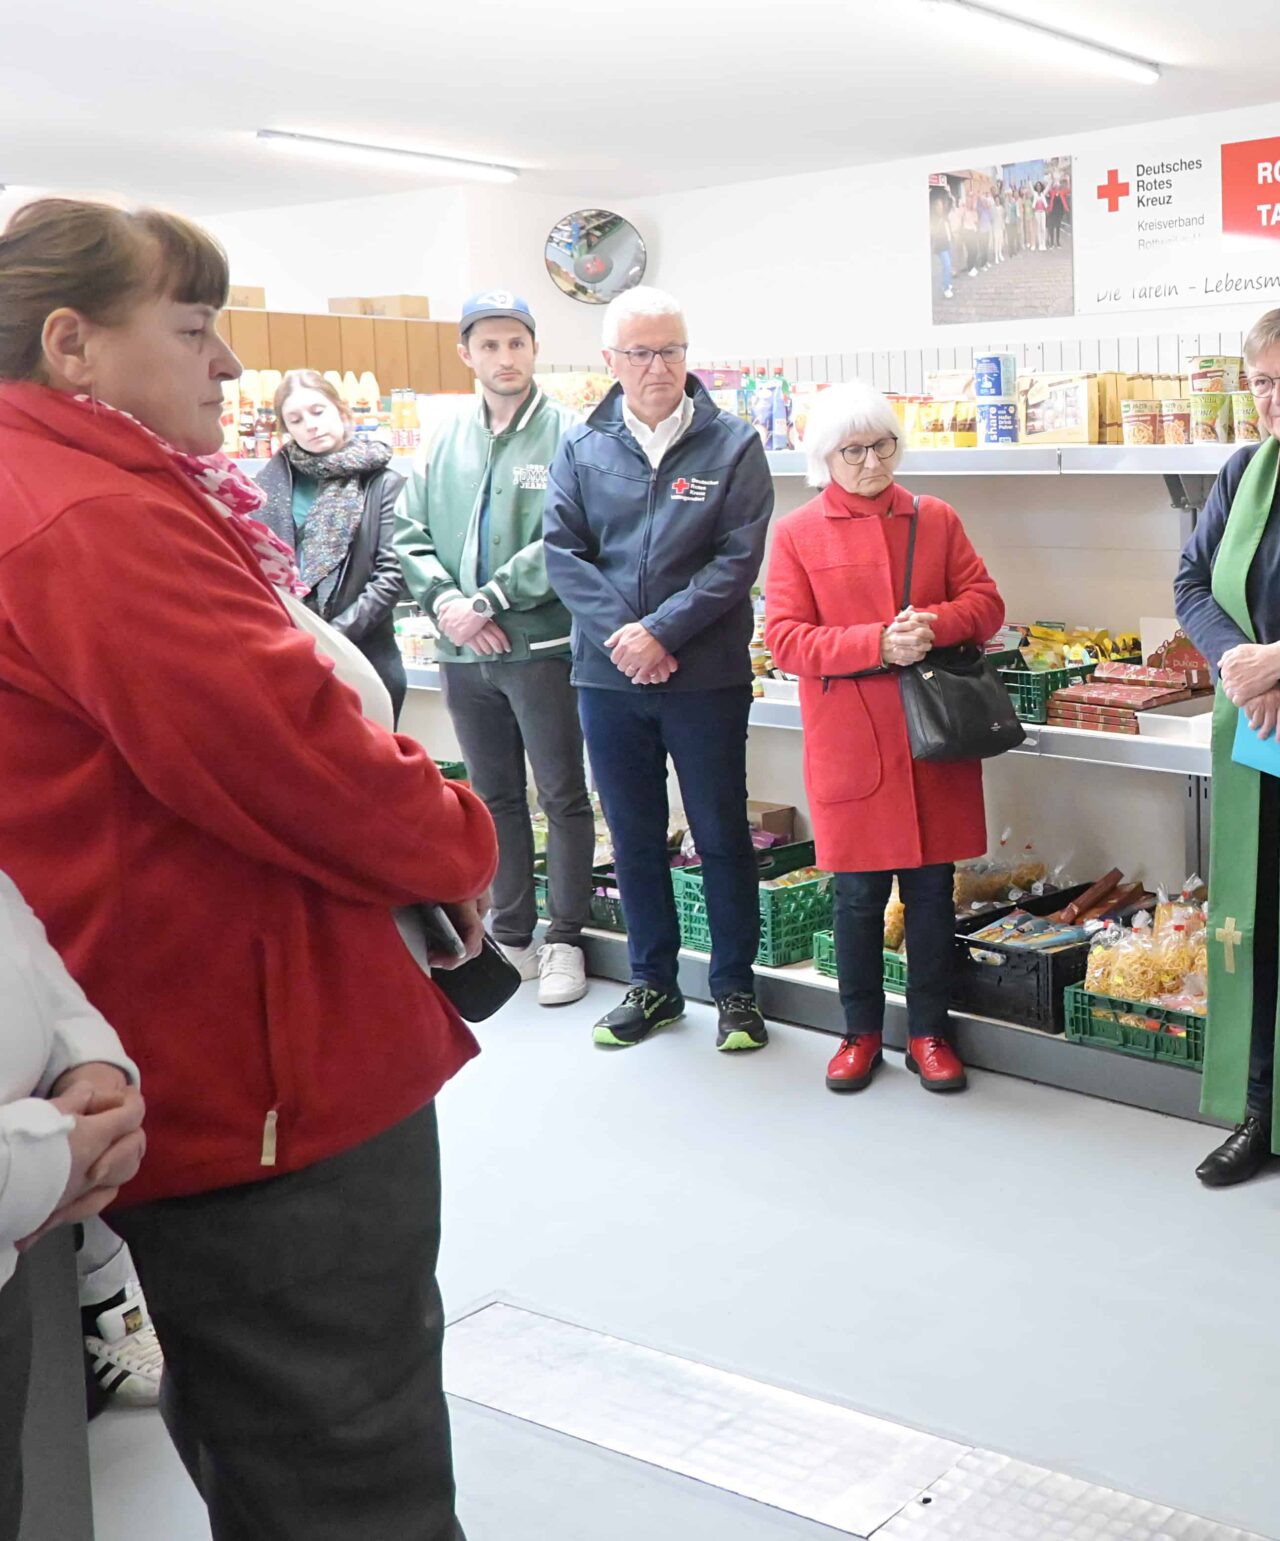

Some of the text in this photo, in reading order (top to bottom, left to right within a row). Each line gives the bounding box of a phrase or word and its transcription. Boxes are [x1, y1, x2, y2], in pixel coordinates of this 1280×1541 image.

[1136, 158, 1202, 177] Deutsches
[1136, 178, 1173, 192] Rotes
[1136, 194, 1173, 208] Kreuz
[1137, 214, 1205, 232] Kreisverband
[988, 406, 998, 441] share
[512, 466, 548, 486] TOMM
